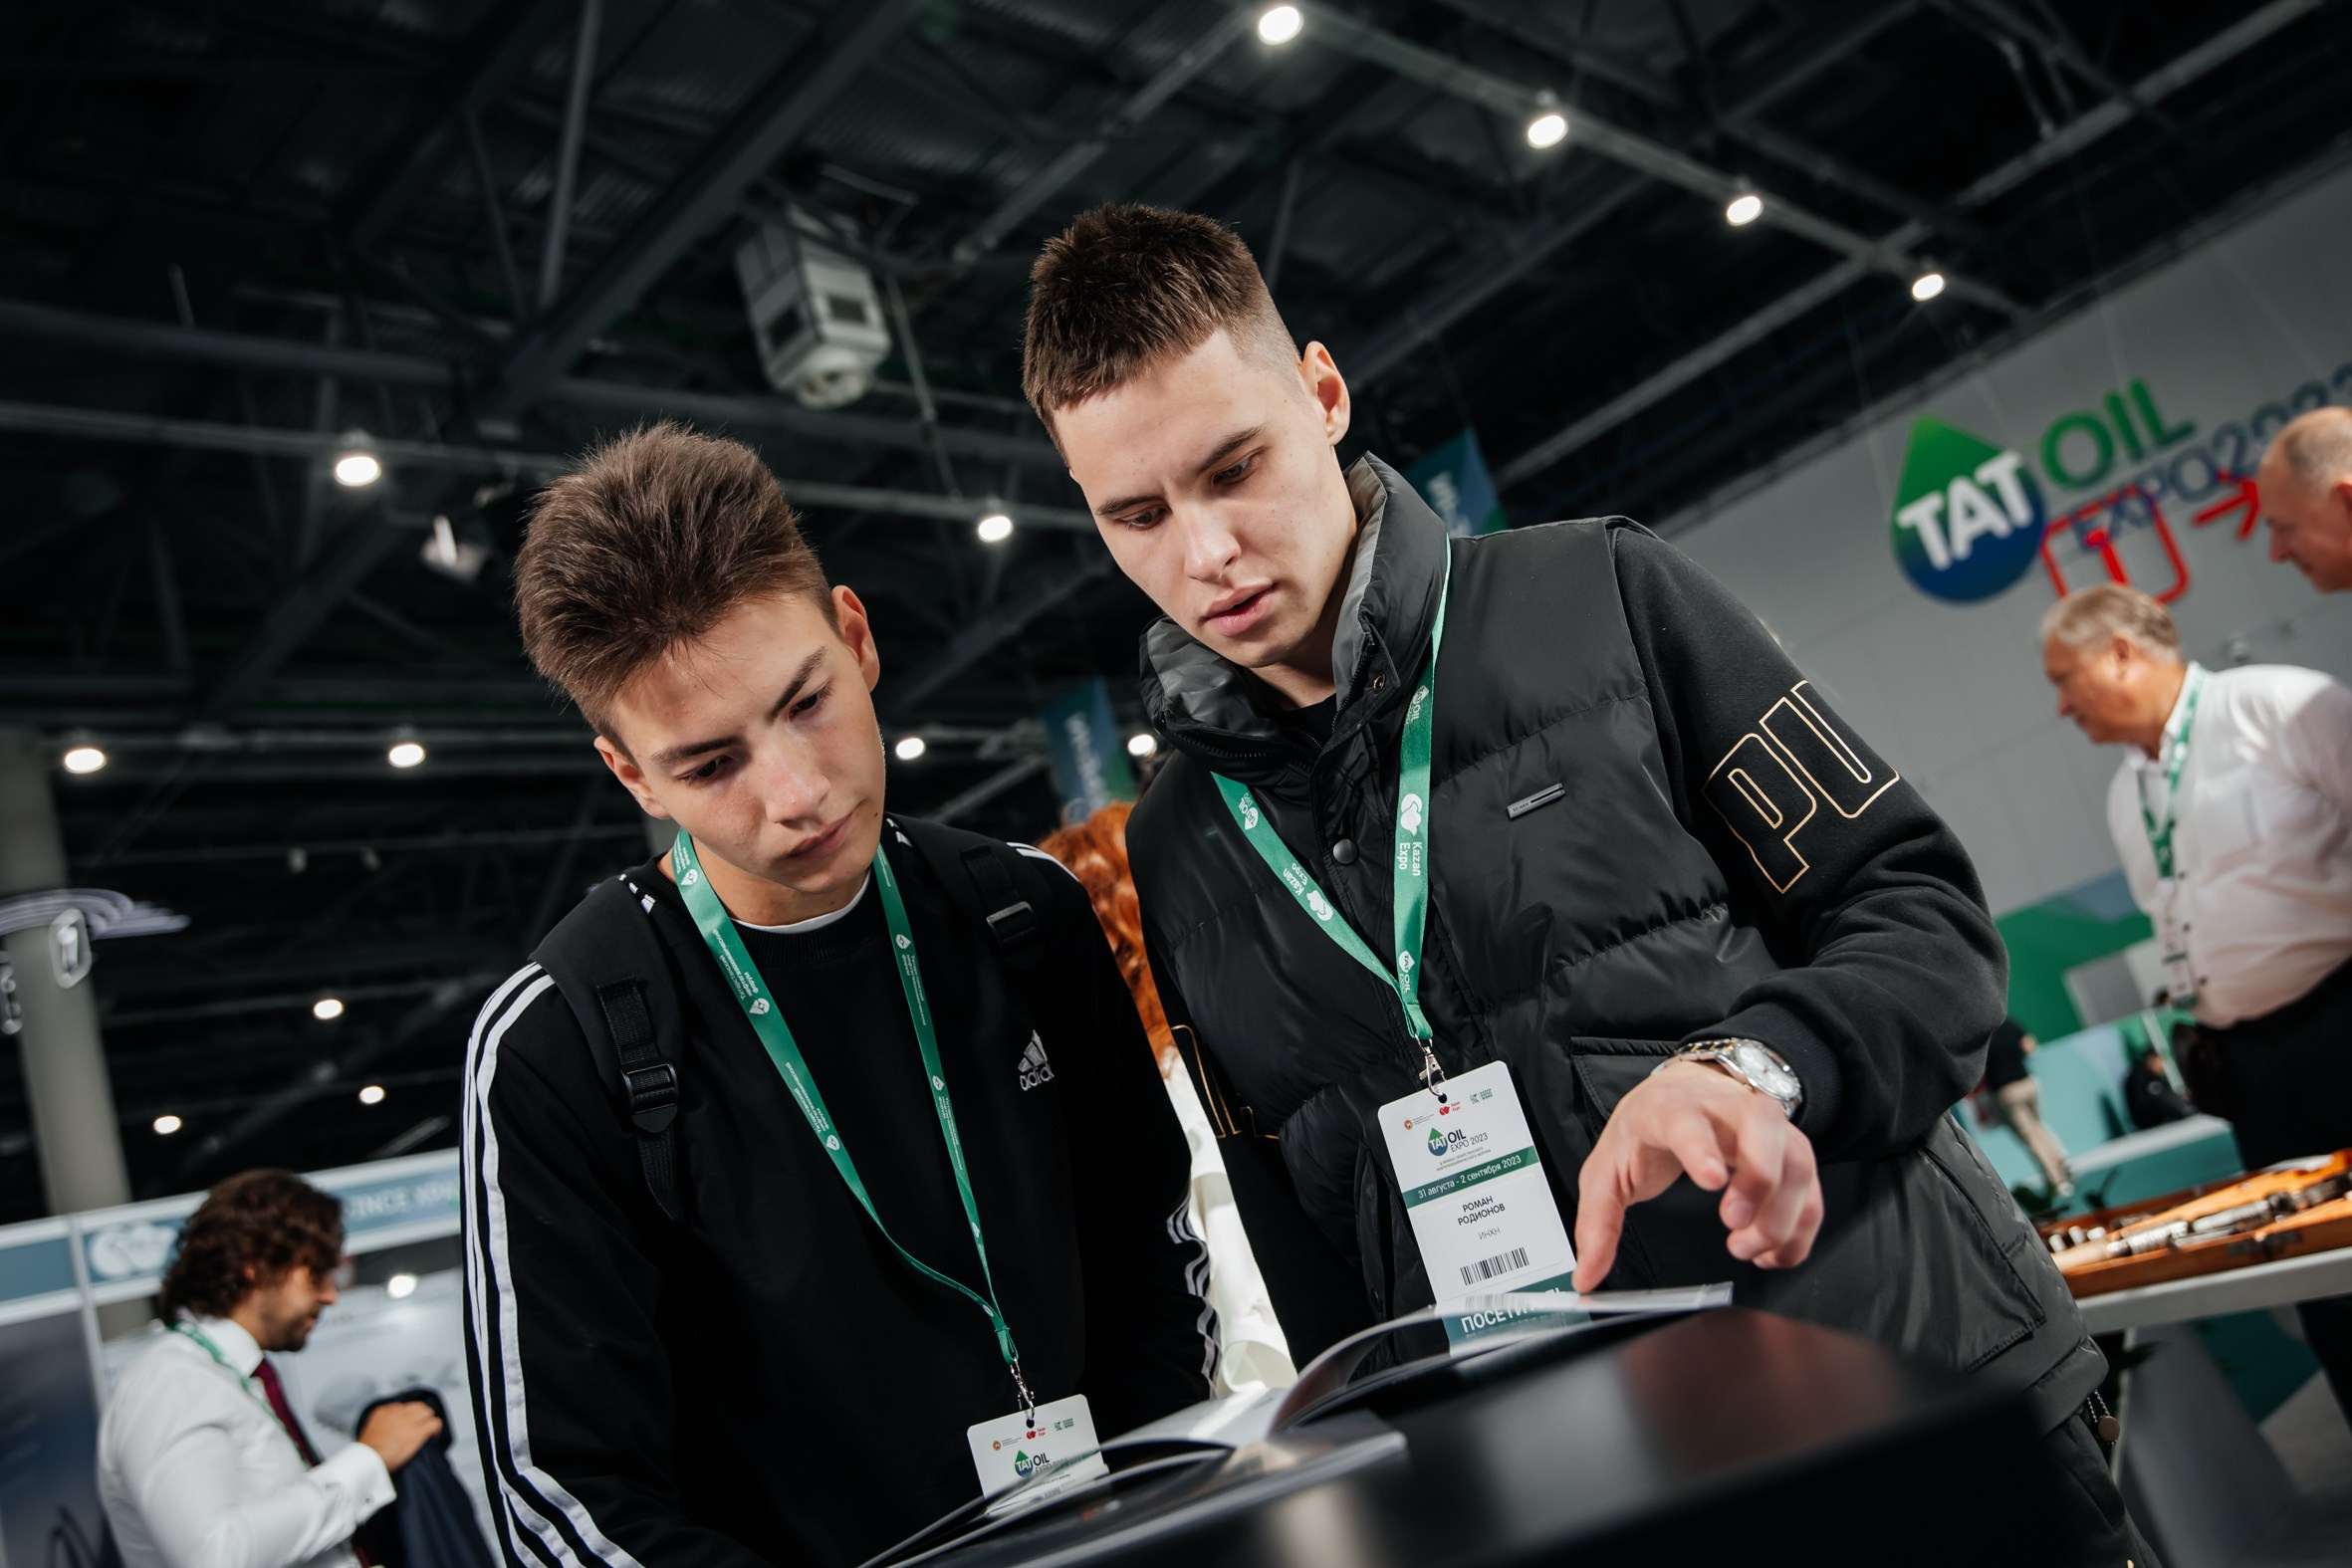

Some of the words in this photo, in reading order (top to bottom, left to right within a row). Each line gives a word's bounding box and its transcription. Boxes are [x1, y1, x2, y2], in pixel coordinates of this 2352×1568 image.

[1896, 450, 2033, 570] TAT
[2040, 377, 2195, 490] OIL
[1411, 704, 1421, 723] OIL
[1238, 797, 1249, 815] OIL
[1243, 792, 1254, 807] EXPO
[1246, 810, 1257, 826] TAT
[1399, 842, 1411, 870] Expo
[1412, 841, 1422, 877] Kazan
[1284, 868, 1304, 896] Kazan
[1292, 862, 1308, 886] Expo
[719, 954, 747, 1001] Татарстанский
[744, 971, 760, 995] форум
[1429, 1136, 1447, 1151] TAT
[1448, 1128, 1467, 1144] OIL
[1450, 1140, 1470, 1153] EXPO
[1471, 1132, 1489, 1146] 2023
[1418, 1189, 1427, 1199] 31
[1428, 1180, 1455, 1195] августа
[1460, 1175, 1467, 1184] 2
[1467, 1163, 1502, 1181] сентября
[1503, 1155, 1522, 1169] 2023
[1458, 1203, 1506, 1226] РОДИОНОВ
[1462, 1196, 1494, 1213] РОМАН
[1016, 1459, 1033, 1471] TAT
[1033, 1453, 1051, 1465] OIL
